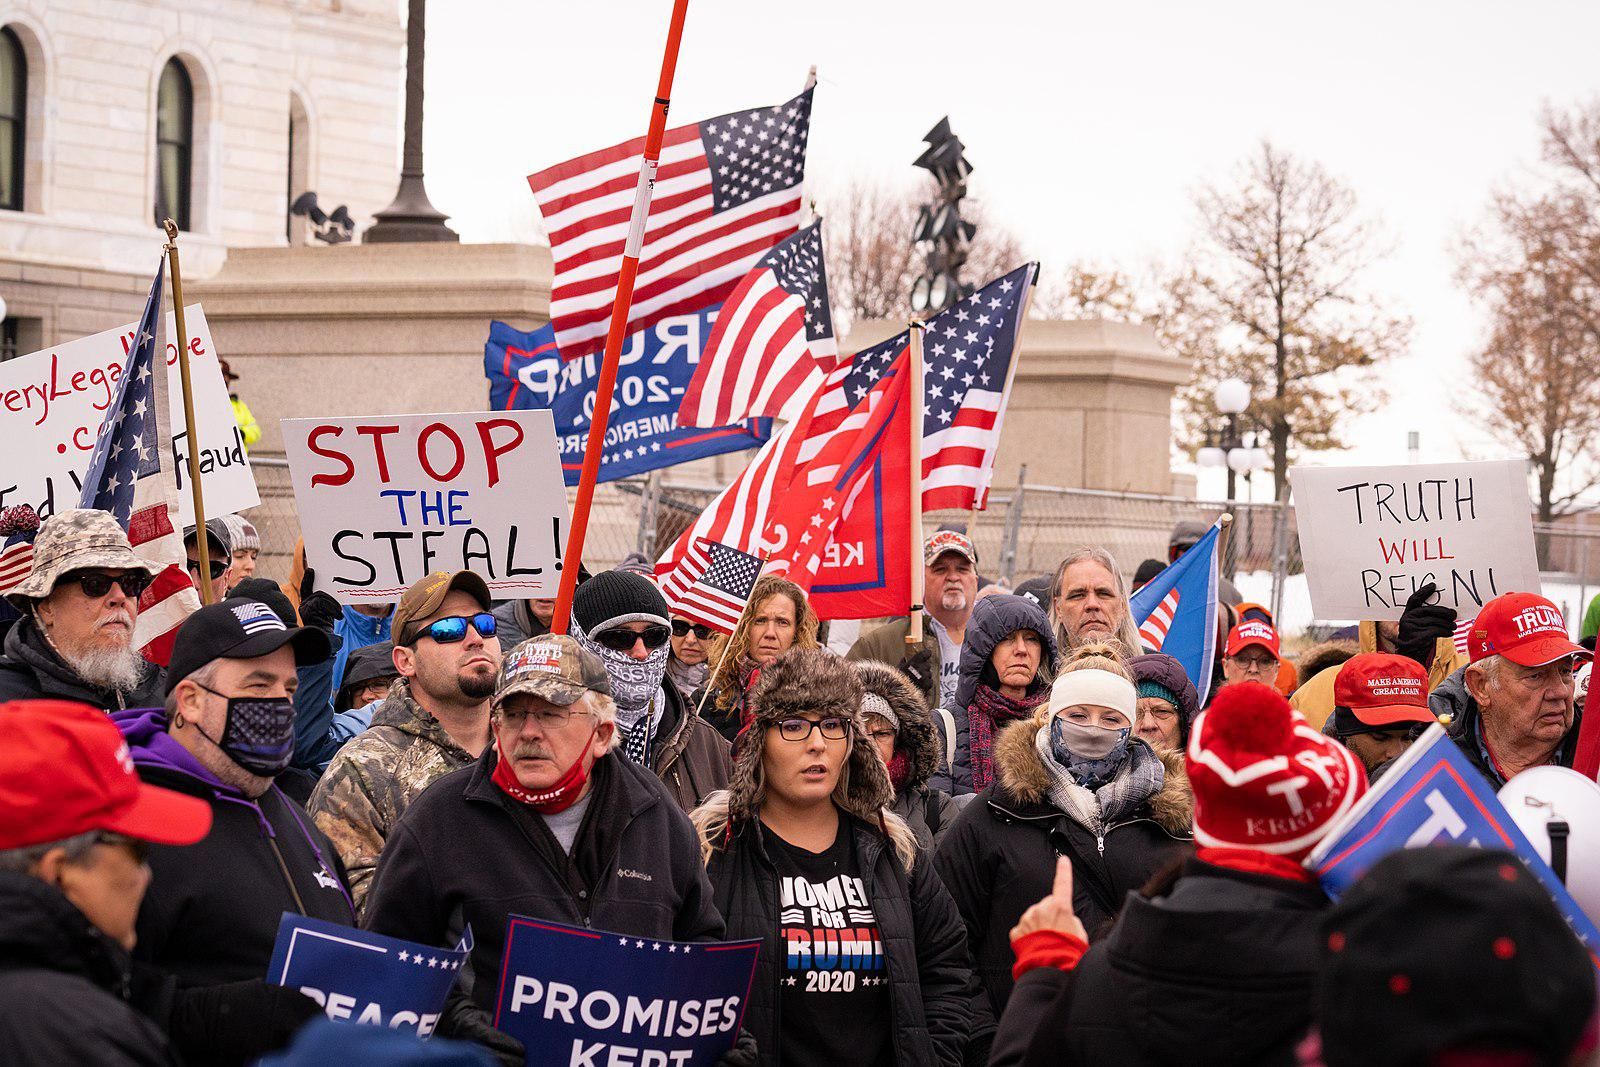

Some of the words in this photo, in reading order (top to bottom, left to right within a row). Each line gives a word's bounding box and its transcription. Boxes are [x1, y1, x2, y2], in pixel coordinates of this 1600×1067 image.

[307, 418, 525, 489] STOP
[380, 490, 472, 527] THE
[1336, 477, 1476, 524] TRUTH
[331, 516, 564, 586] STEAL!
[1378, 536, 1455, 565] WILL
[527, 655, 548, 664] 2020
[1367, 679, 1391, 687] MAKE
[1392, 677, 1422, 686] AMERICA
[1373, 687, 1399, 696] GREAT
[1400, 687, 1420, 695] AGAIN
[811, 907, 847, 929] FOR
[805, 970, 856, 993] 2020
[510, 974, 740, 1038] PROMISES
